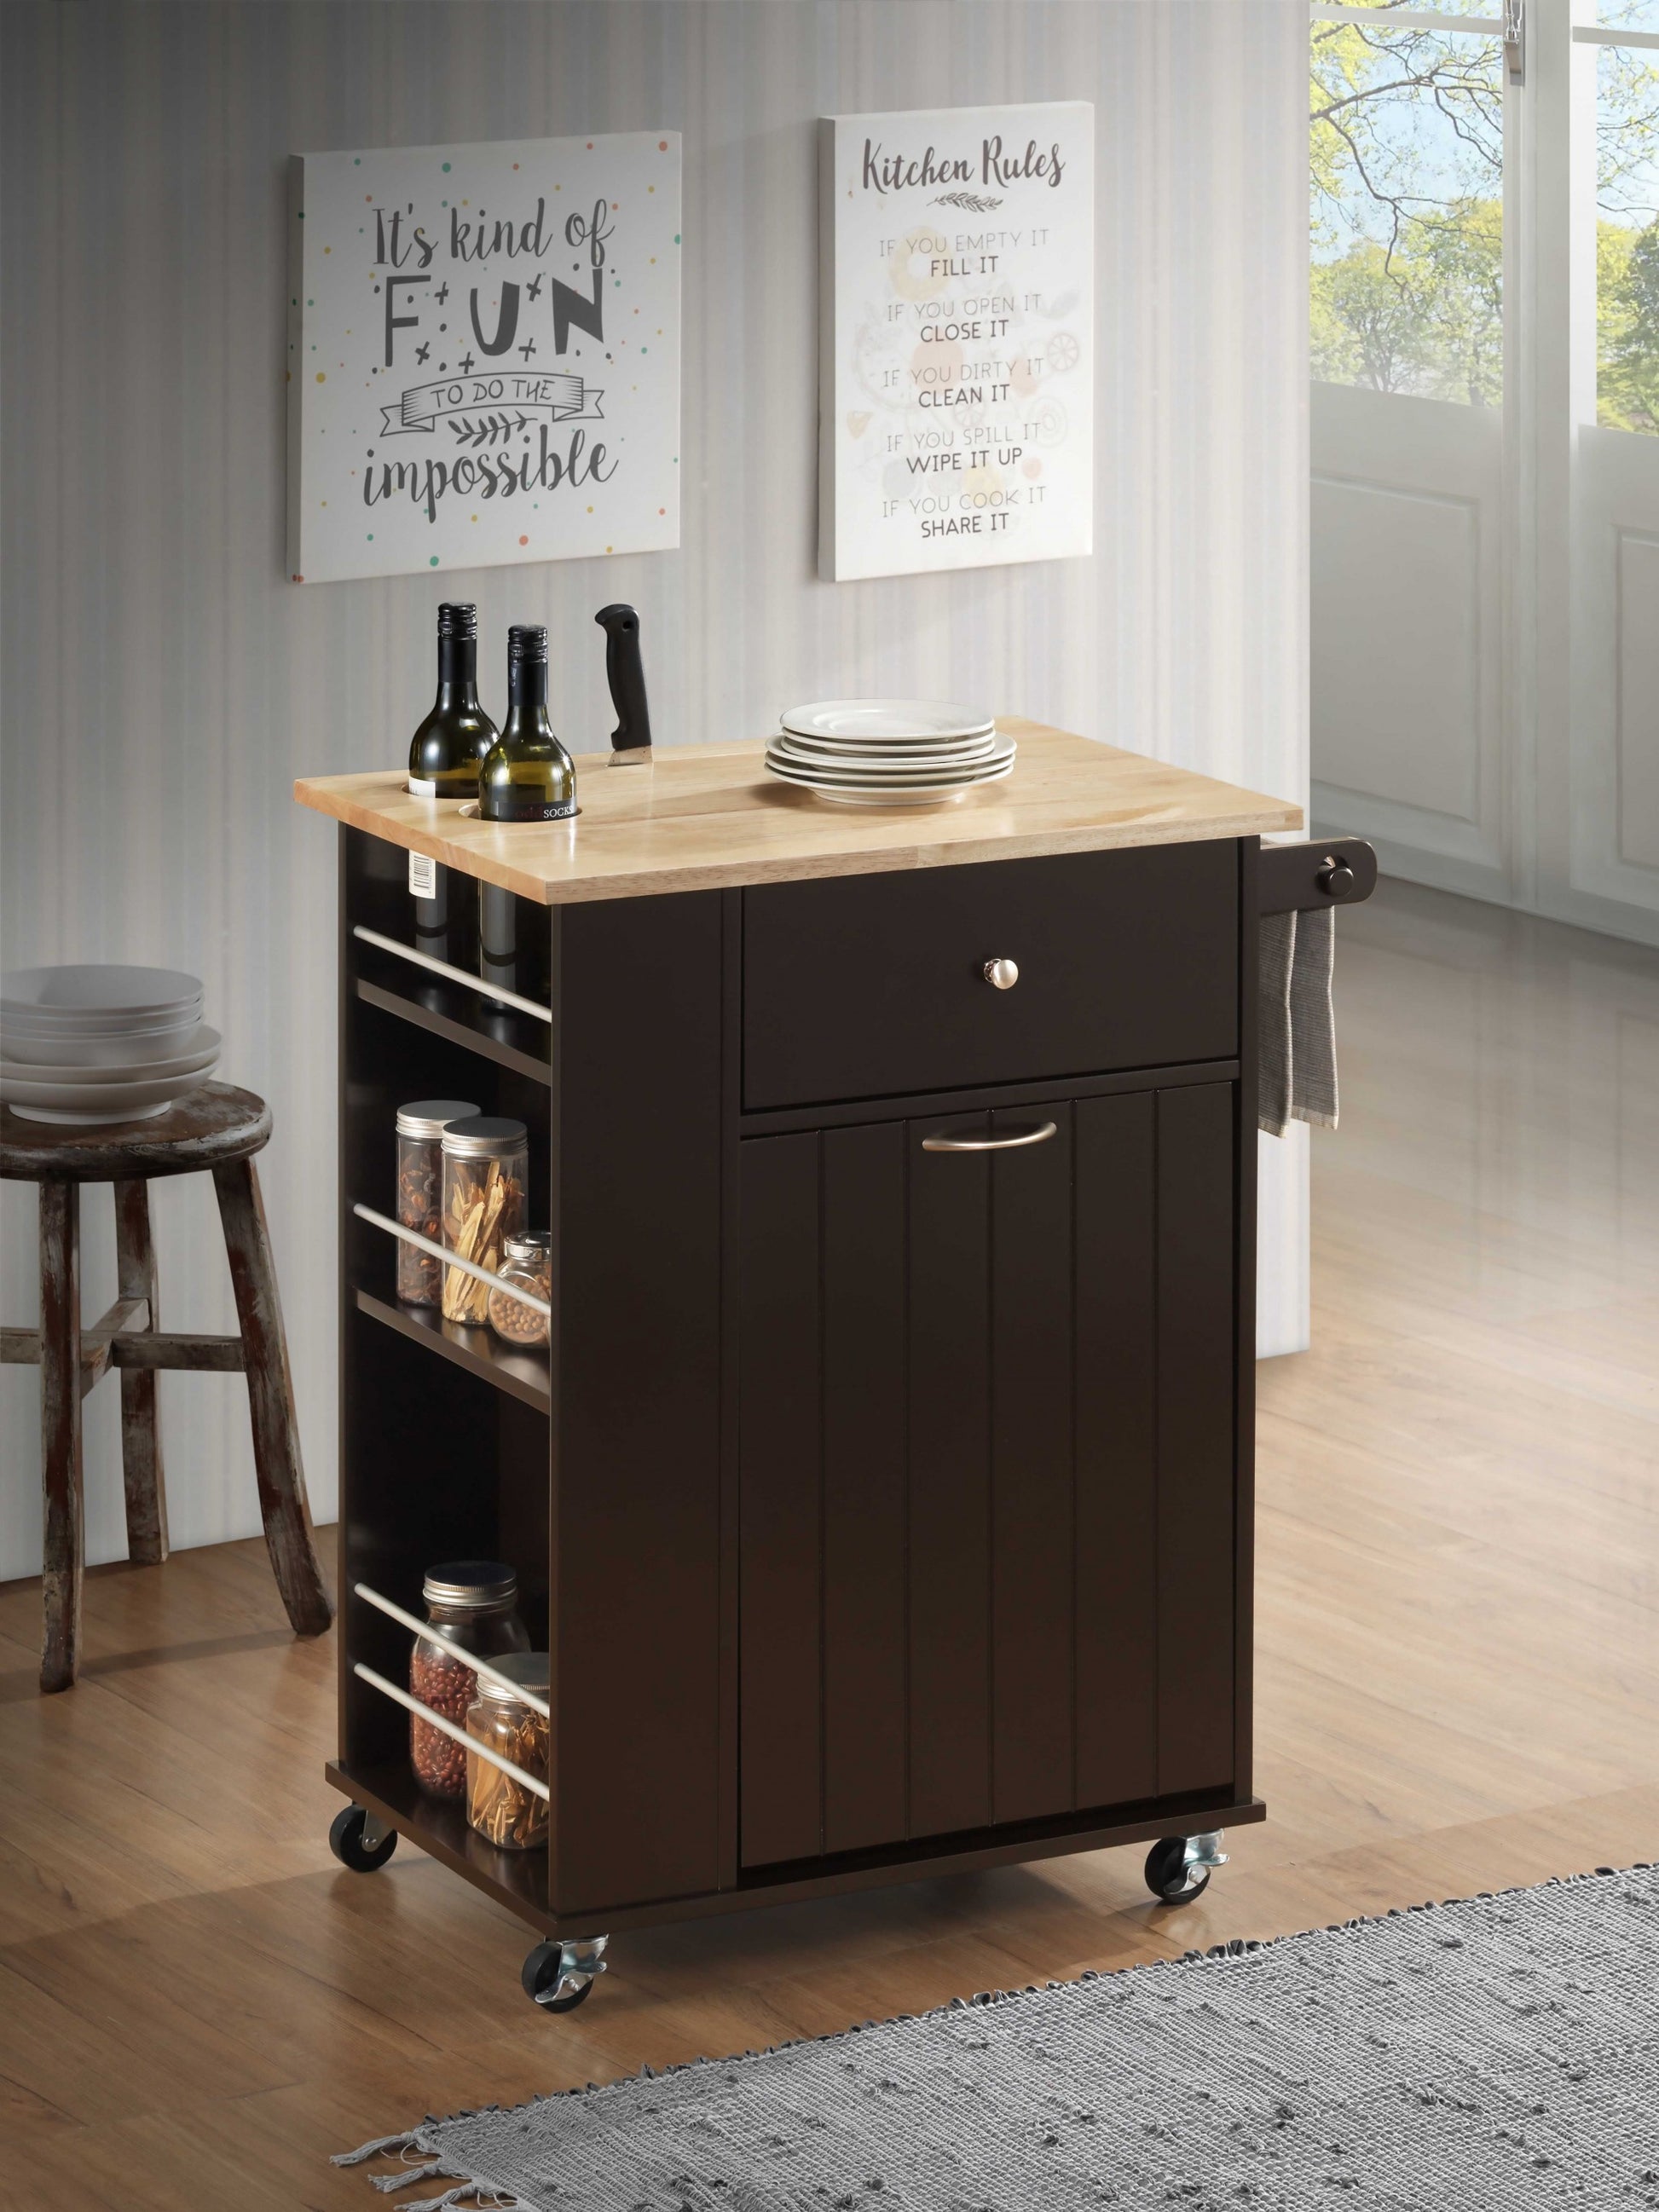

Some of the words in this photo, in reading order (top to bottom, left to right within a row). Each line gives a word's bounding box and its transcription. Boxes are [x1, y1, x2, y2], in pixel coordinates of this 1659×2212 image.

[863, 137, 975, 195] Kitchen
[982, 135, 1066, 188] Rules
[371, 202, 439, 269] It's
[450, 196, 553, 263] kind
[564, 198, 616, 268] of
[879, 240, 896, 257] IF
[905, 236, 947, 254] YOU
[956, 231, 1022, 252] EMPTY
[1031, 228, 1049, 246] IT
[930, 258, 971, 277] FILL
[980, 256, 999, 274] IT
[887, 303, 905, 322] IF
[913, 301, 955, 319] YOU
[963, 296, 1014, 315] OPEN
[1024, 293, 1042, 312] IT
[920, 321, 981, 343] CLOSE
[990, 319, 1009, 338] IT
[882, 369, 900, 388] IF
[910, 366, 951, 384] YOU
[960, 361, 1016, 381] DIRTY
[1026, 357, 1044, 376] IT
[430, 384, 464, 409] TO
[472, 379, 505, 402] DO
[511, 378, 556, 402] THE
[918, 386, 982, 408] CLEAN
[991, 384, 1010, 401] IT
[887, 434, 904, 453] IF
[913, 430, 954, 449] YOU
[963, 425, 1014, 445] SPILL
[1023, 422, 1041, 441] IT
[363, 424, 619, 524] impossible
[906, 453, 962, 474] WIPE
[970, 450, 990, 468] IT
[997, 447, 1023, 465] UP
[882, 500, 899, 518] IF
[909, 495, 951, 515] YOU
[959, 489, 1020, 511] COOK
[1028, 486, 1047, 504] IT
[921, 516, 982, 538] SHARE
[991, 512, 1009, 531] IT
[543, 806, 574, 818] SOCKS
